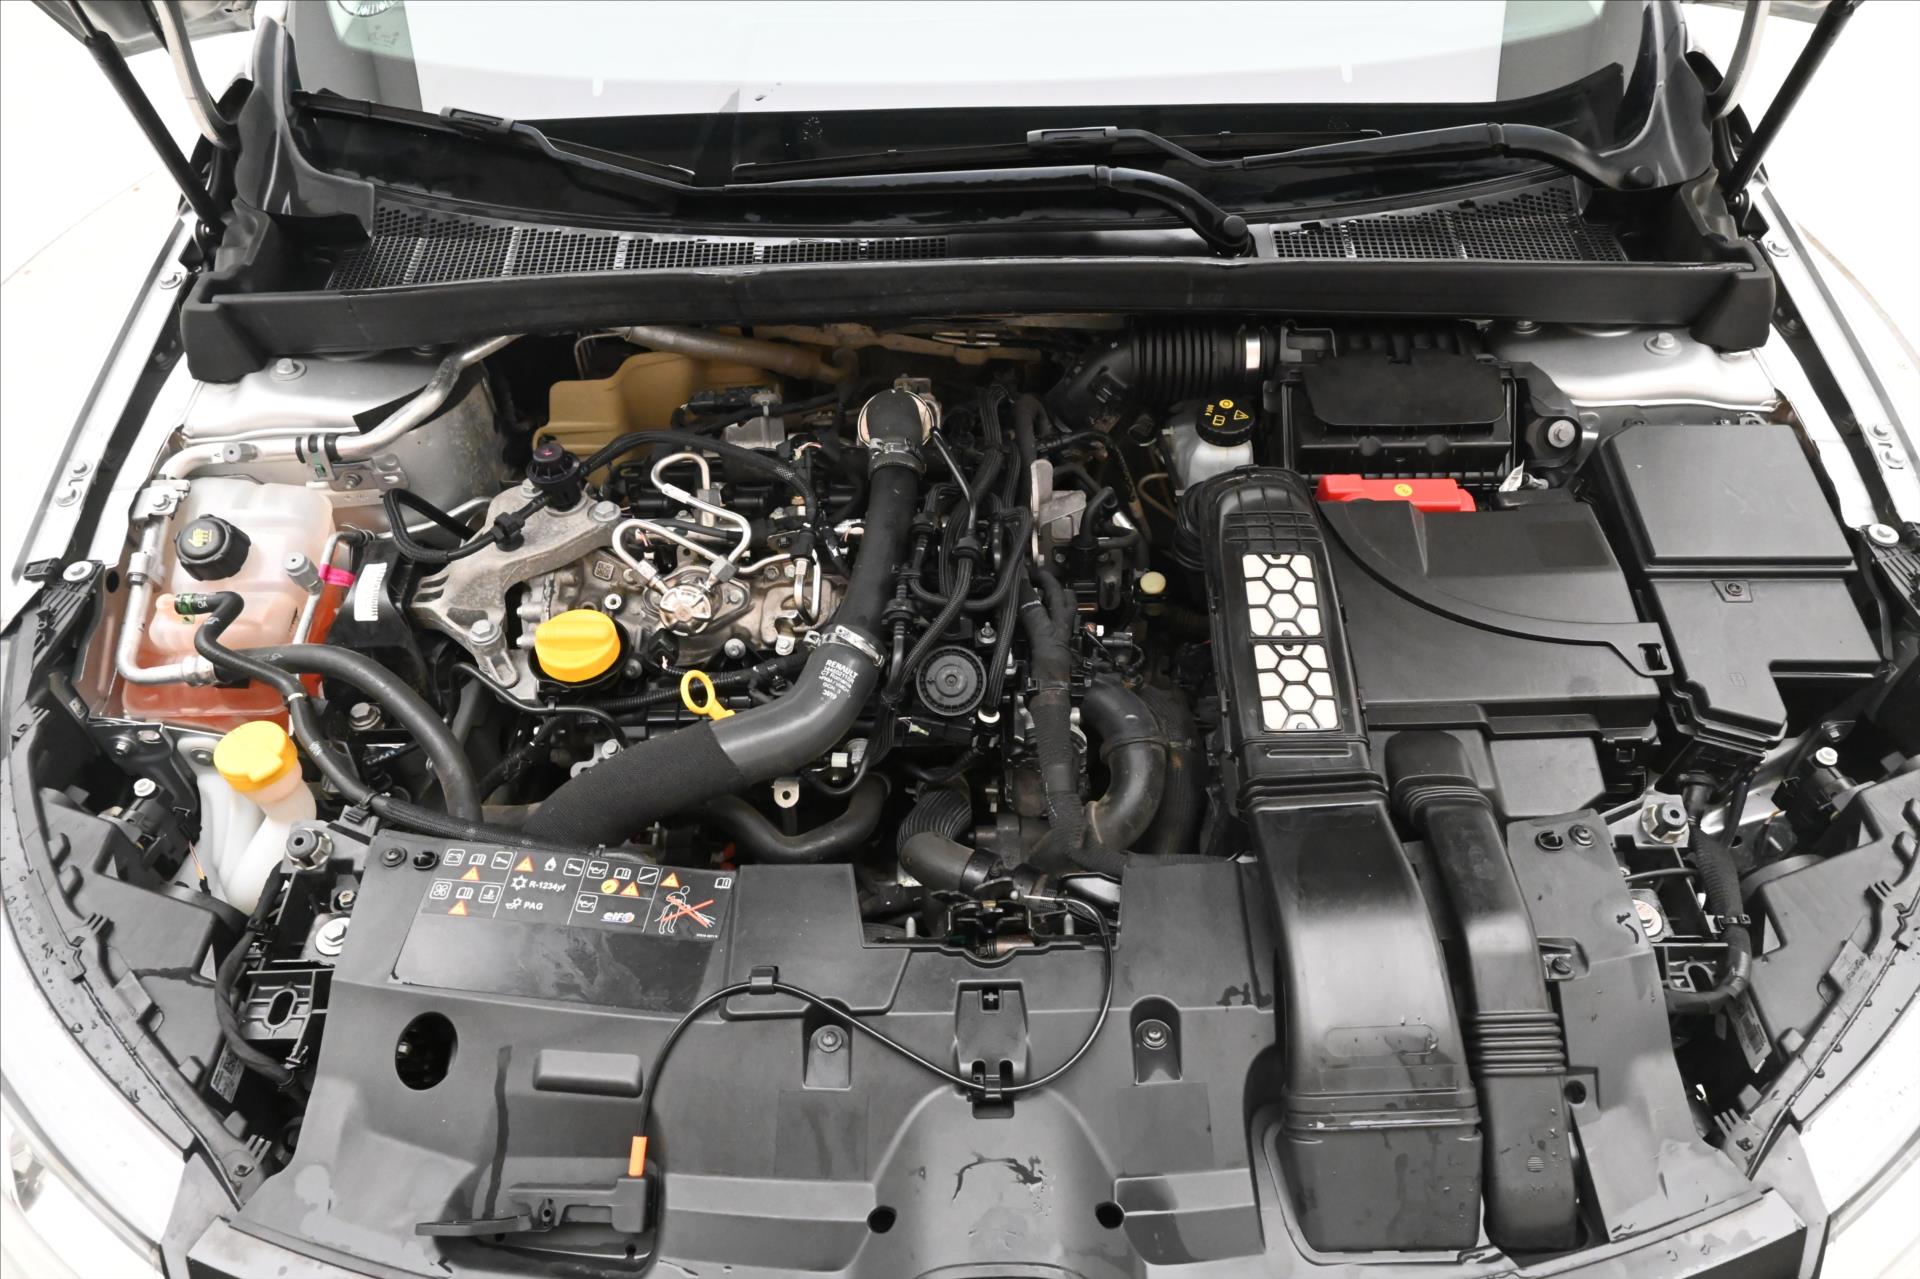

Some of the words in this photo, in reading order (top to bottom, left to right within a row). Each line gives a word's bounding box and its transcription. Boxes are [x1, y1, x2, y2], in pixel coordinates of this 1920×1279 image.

[825, 659, 858, 678] RENAULT
[529, 880, 566, 892] R-1234yf
[523, 901, 543, 910] PAG
